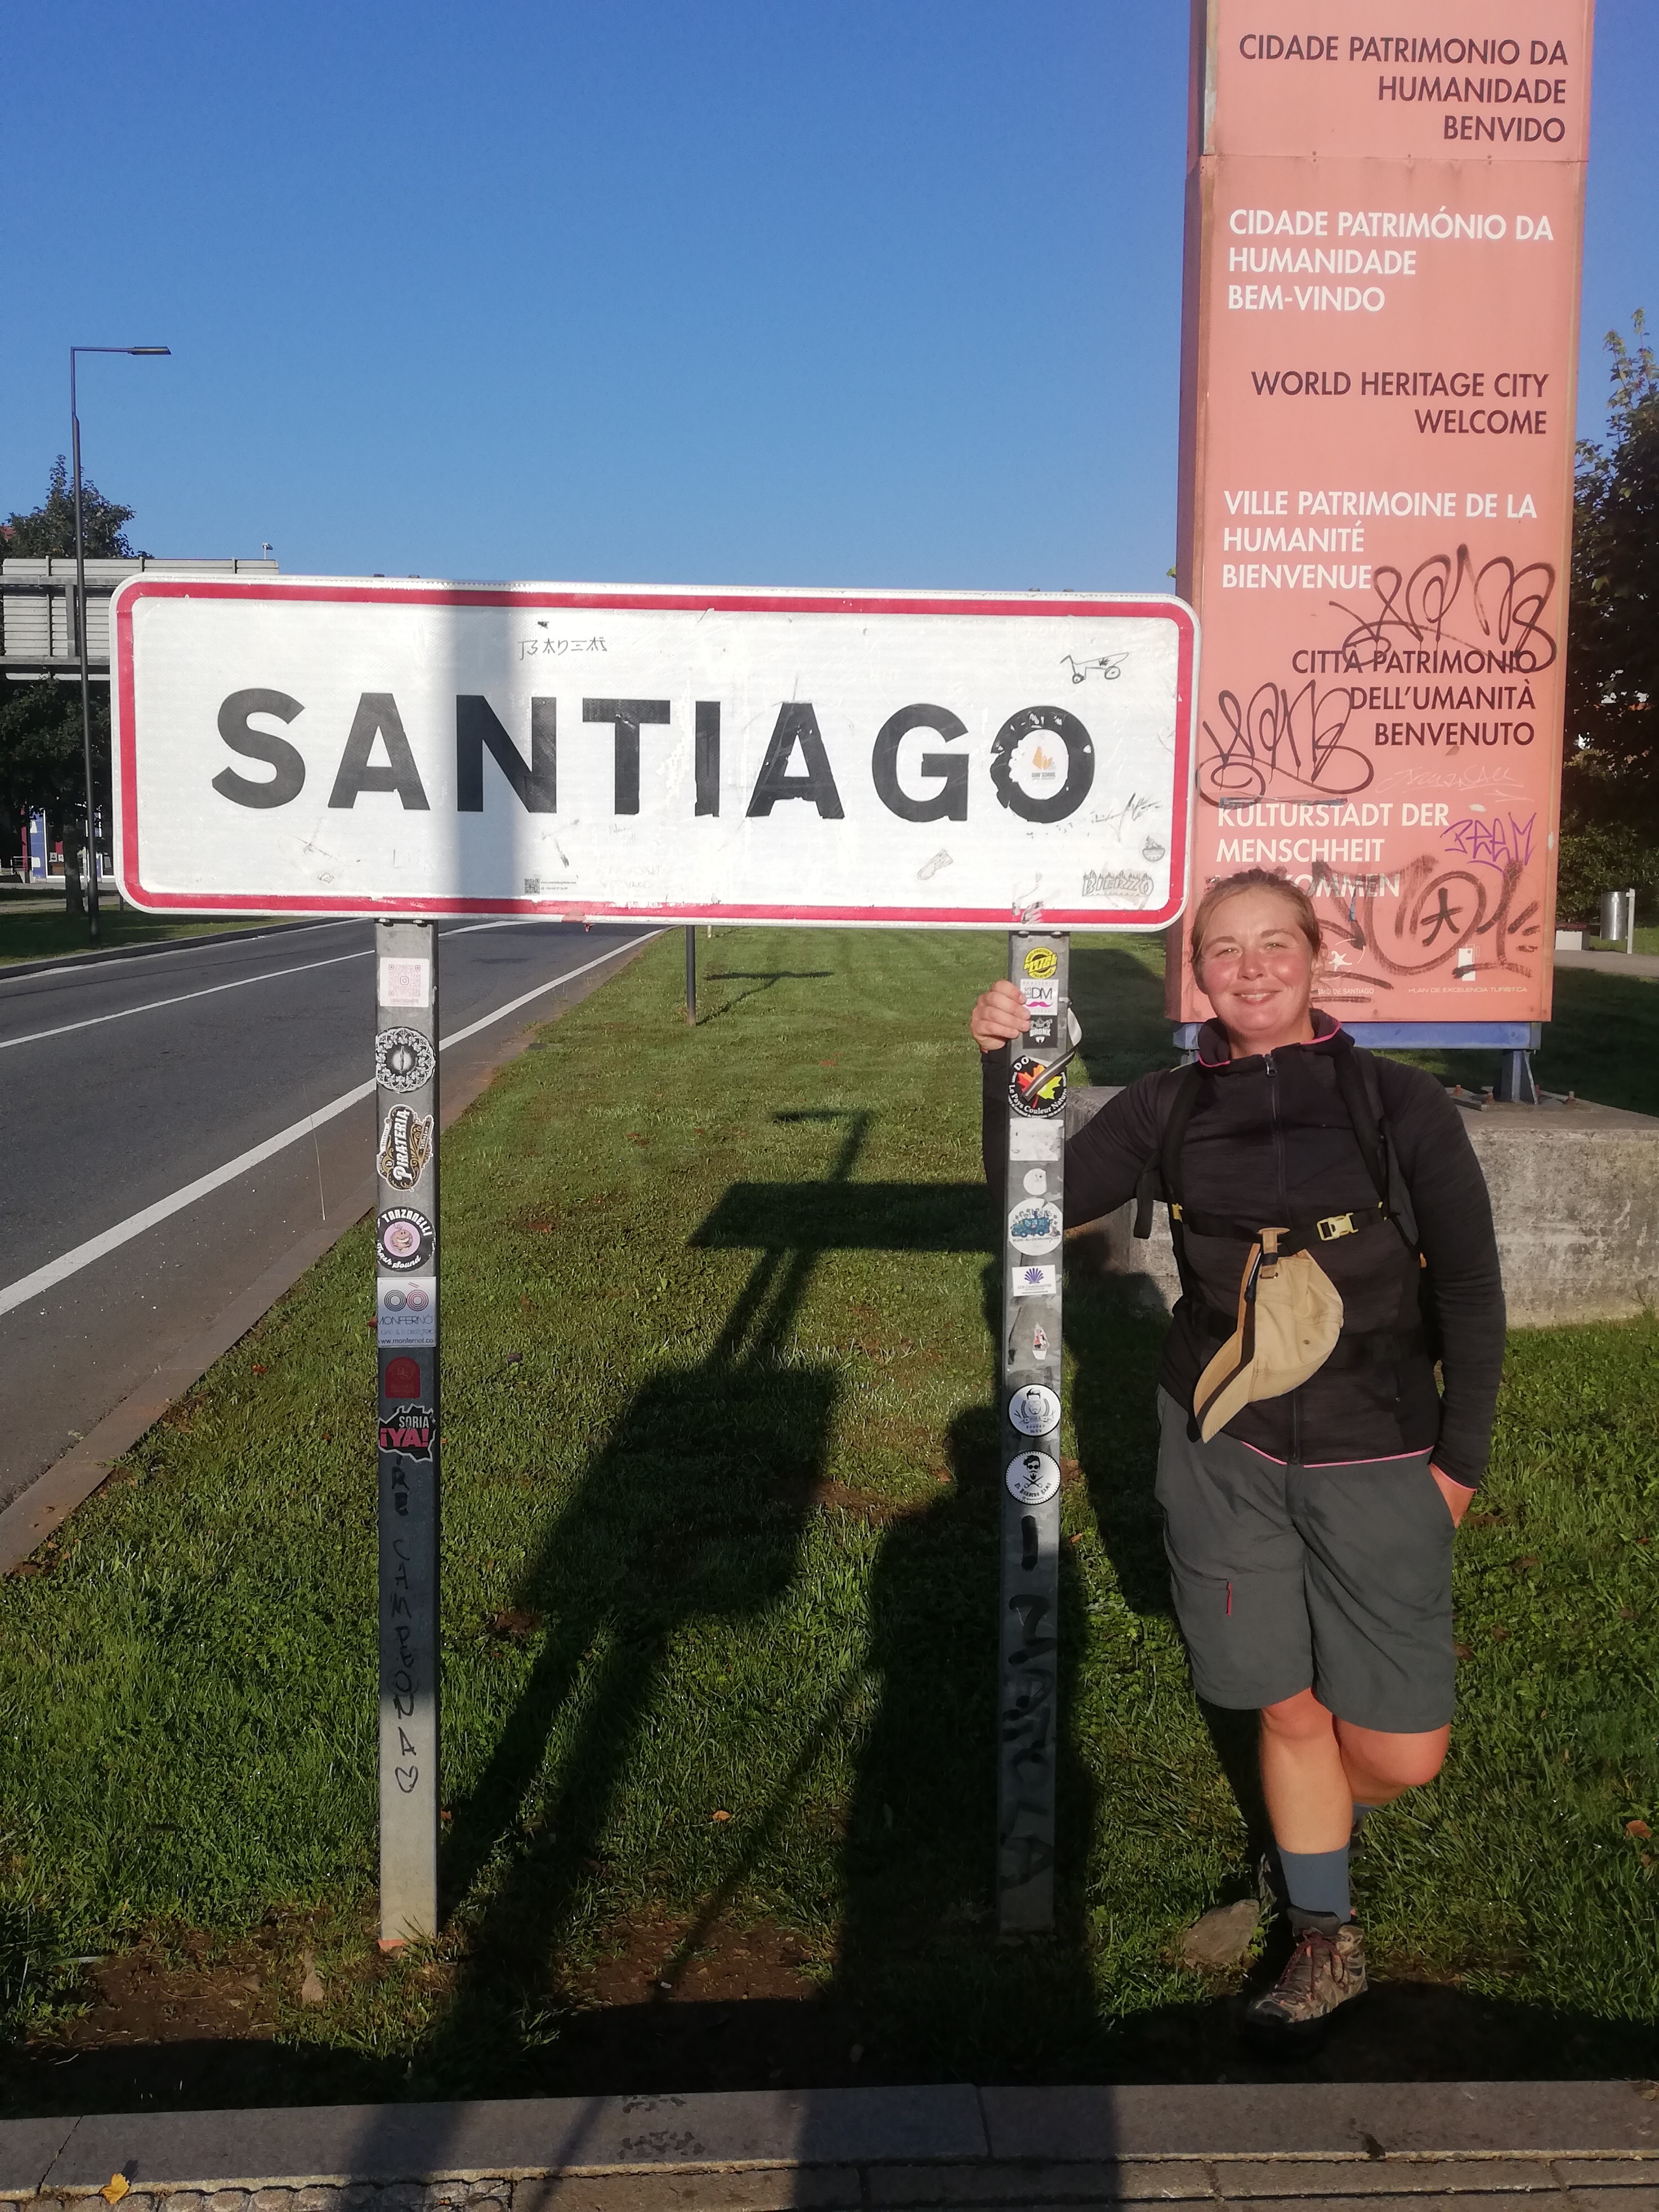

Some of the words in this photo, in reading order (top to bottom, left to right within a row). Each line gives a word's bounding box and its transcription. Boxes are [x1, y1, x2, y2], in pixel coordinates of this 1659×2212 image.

[1240, 35, 1338, 61] CIDADE
[1350, 36, 1519, 65] PATRIMONIO
[1530, 40, 1568, 65] DA
[1379, 76, 1566, 103] HUMANIDADE
[1444, 116, 1565, 143] BENVIDO
[1230, 209, 1328, 236] CIDADE
[1338, 206, 1506, 240] PATRIMÓNIO
[1516, 216, 1553, 240] DA
[1229, 248, 1416, 274] HUMANIDADE
[1229, 285, 1384, 311] BEM-VINDO
[1251, 371, 1350, 396] WORLD
[1362, 372, 1484, 397] HERITAGE
[1494, 373, 1549, 397] CITY
[1415, 409, 1546, 434] WELCOME
[1224, 491, 1287, 515] VILLE
[1298, 491, 1456, 517] PATRIMOINE
[1467, 493, 1497, 517] DE
[1507, 494, 1537, 518] LA
[1224, 520, 1364, 552] HUMANITÉ
[1223, 564, 1371, 589] BIENVENUE
[1373, 649, 1536, 674] PATRIMONIO
[1375, 722, 1534, 746] BENVENUTO
[212, 688, 1094, 823] SANTIAGO
[1218, 802, 1393, 827] KULTURSTADT
[1402, 803, 1449, 826] DER
[1216, 839, 1384, 862] MENSCHHEIT
[1082, 870, 1154, 896] BIERZO
[1032, 987, 1052, 999] DM
[1009, 1085, 1016, 1094] Le
[1011, 1094, 1024, 1108] Pays
[1024, 1106, 1052, 1115] Couleur
[393, 1110, 413, 1181] PIRATERIA
[381, 1209, 433, 1236] TANZANELLI
[392, 1255, 421, 1268] Sound
[399, 1416, 429, 1428] SORIA
[380, 1428, 429, 1447] ¡YA!
